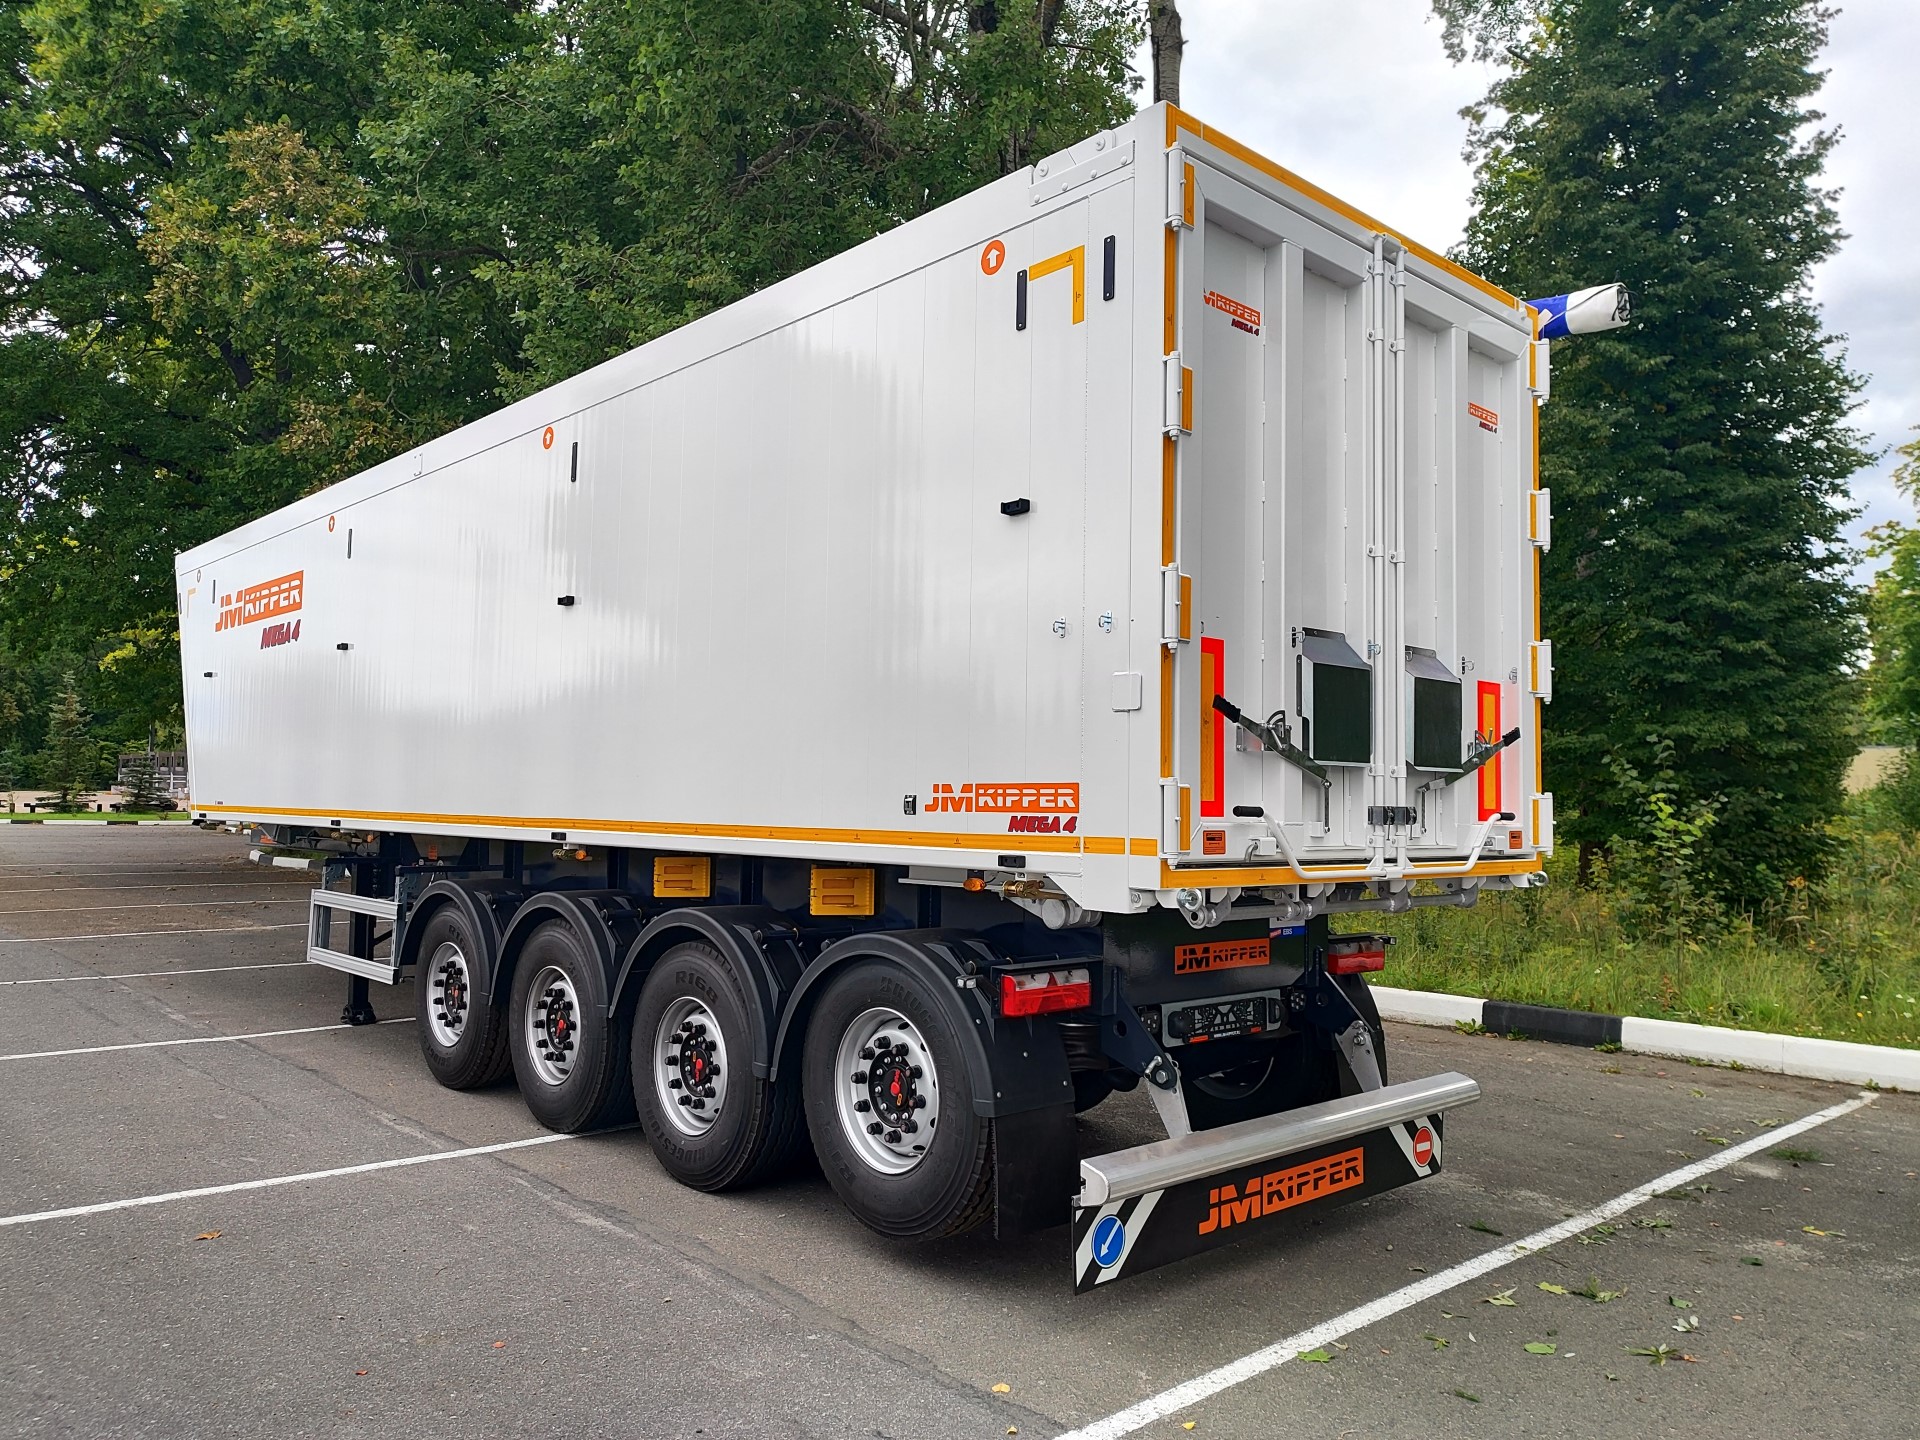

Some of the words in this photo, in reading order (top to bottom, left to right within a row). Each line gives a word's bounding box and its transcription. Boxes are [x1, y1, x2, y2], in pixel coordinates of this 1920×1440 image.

[291, 619, 301, 642] 4
[1008, 816, 1061, 833] MEGA
[1062, 816, 1078, 833] 4
[675, 971, 719, 1006] R168
